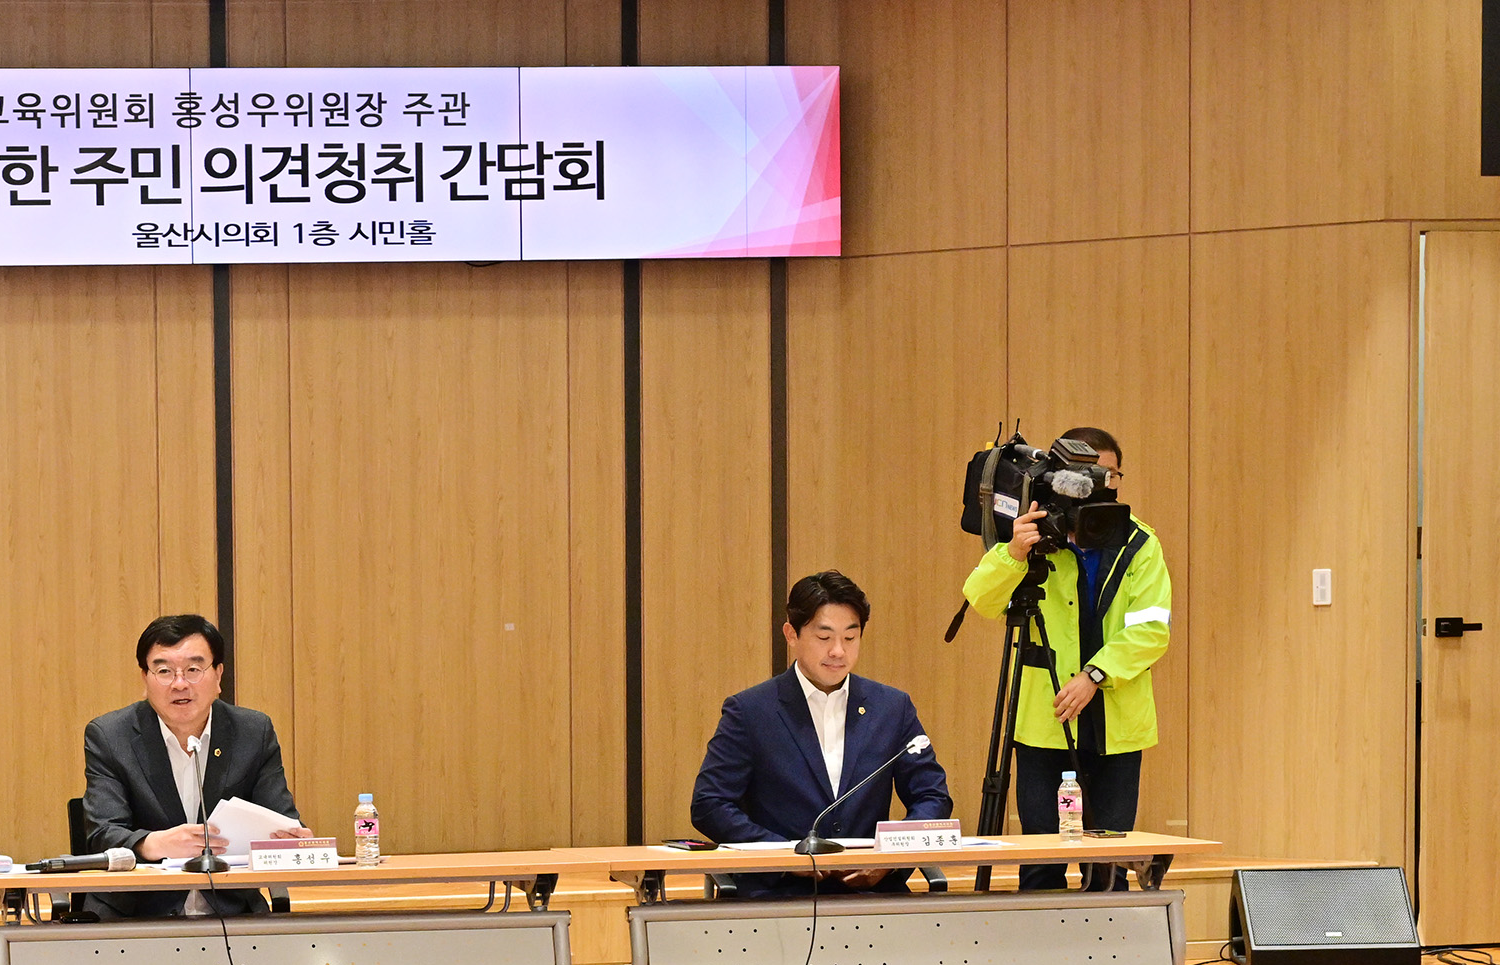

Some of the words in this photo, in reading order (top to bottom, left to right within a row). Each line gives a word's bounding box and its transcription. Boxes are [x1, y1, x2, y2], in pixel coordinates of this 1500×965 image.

[171, 91, 388, 129] 홍성우위원장
[402, 91, 471, 128] 주관
[70, 144, 183, 206] 주민
[200, 142, 425, 205] 의견청취
[440, 140, 605, 201] 간담회
[132, 221, 278, 249] 울산시의회
[293, 221, 340, 247] 1층
[349, 220, 437, 246] 시민홀
